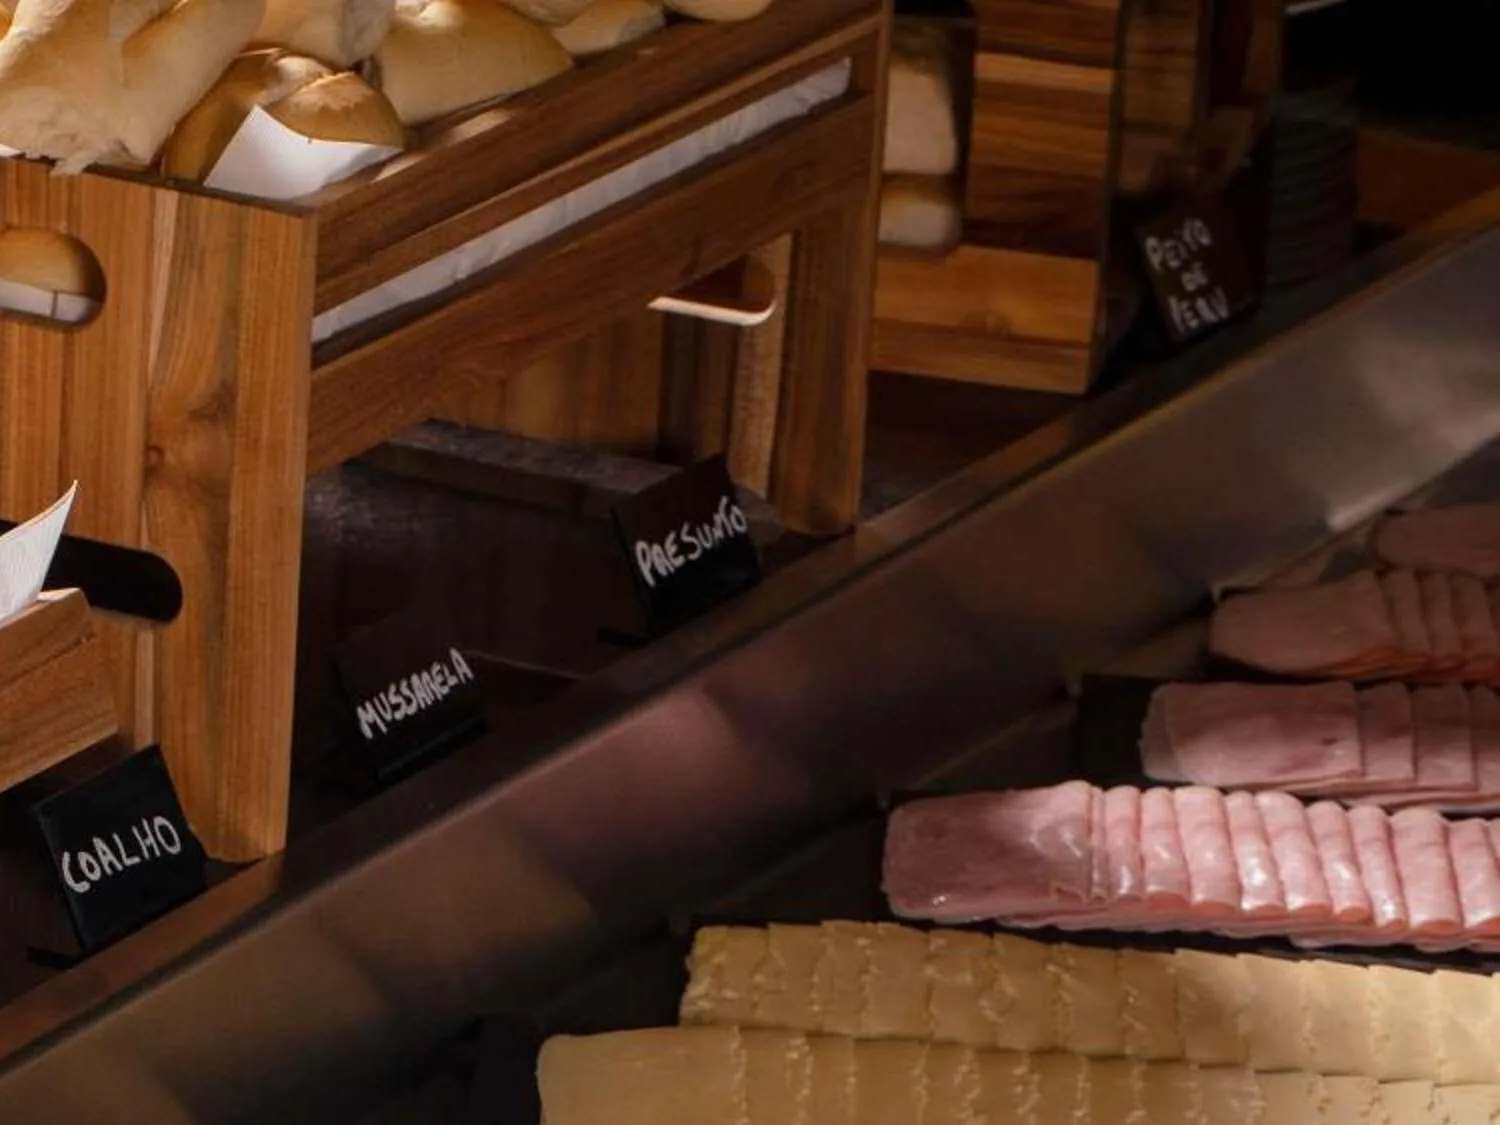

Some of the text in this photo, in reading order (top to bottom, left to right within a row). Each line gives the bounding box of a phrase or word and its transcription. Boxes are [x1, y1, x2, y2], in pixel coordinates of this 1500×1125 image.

[635, 495, 747, 588] PRESUNTO
[356, 647, 474, 739] MUSSARELA
[62, 815, 181, 893] COALHO
